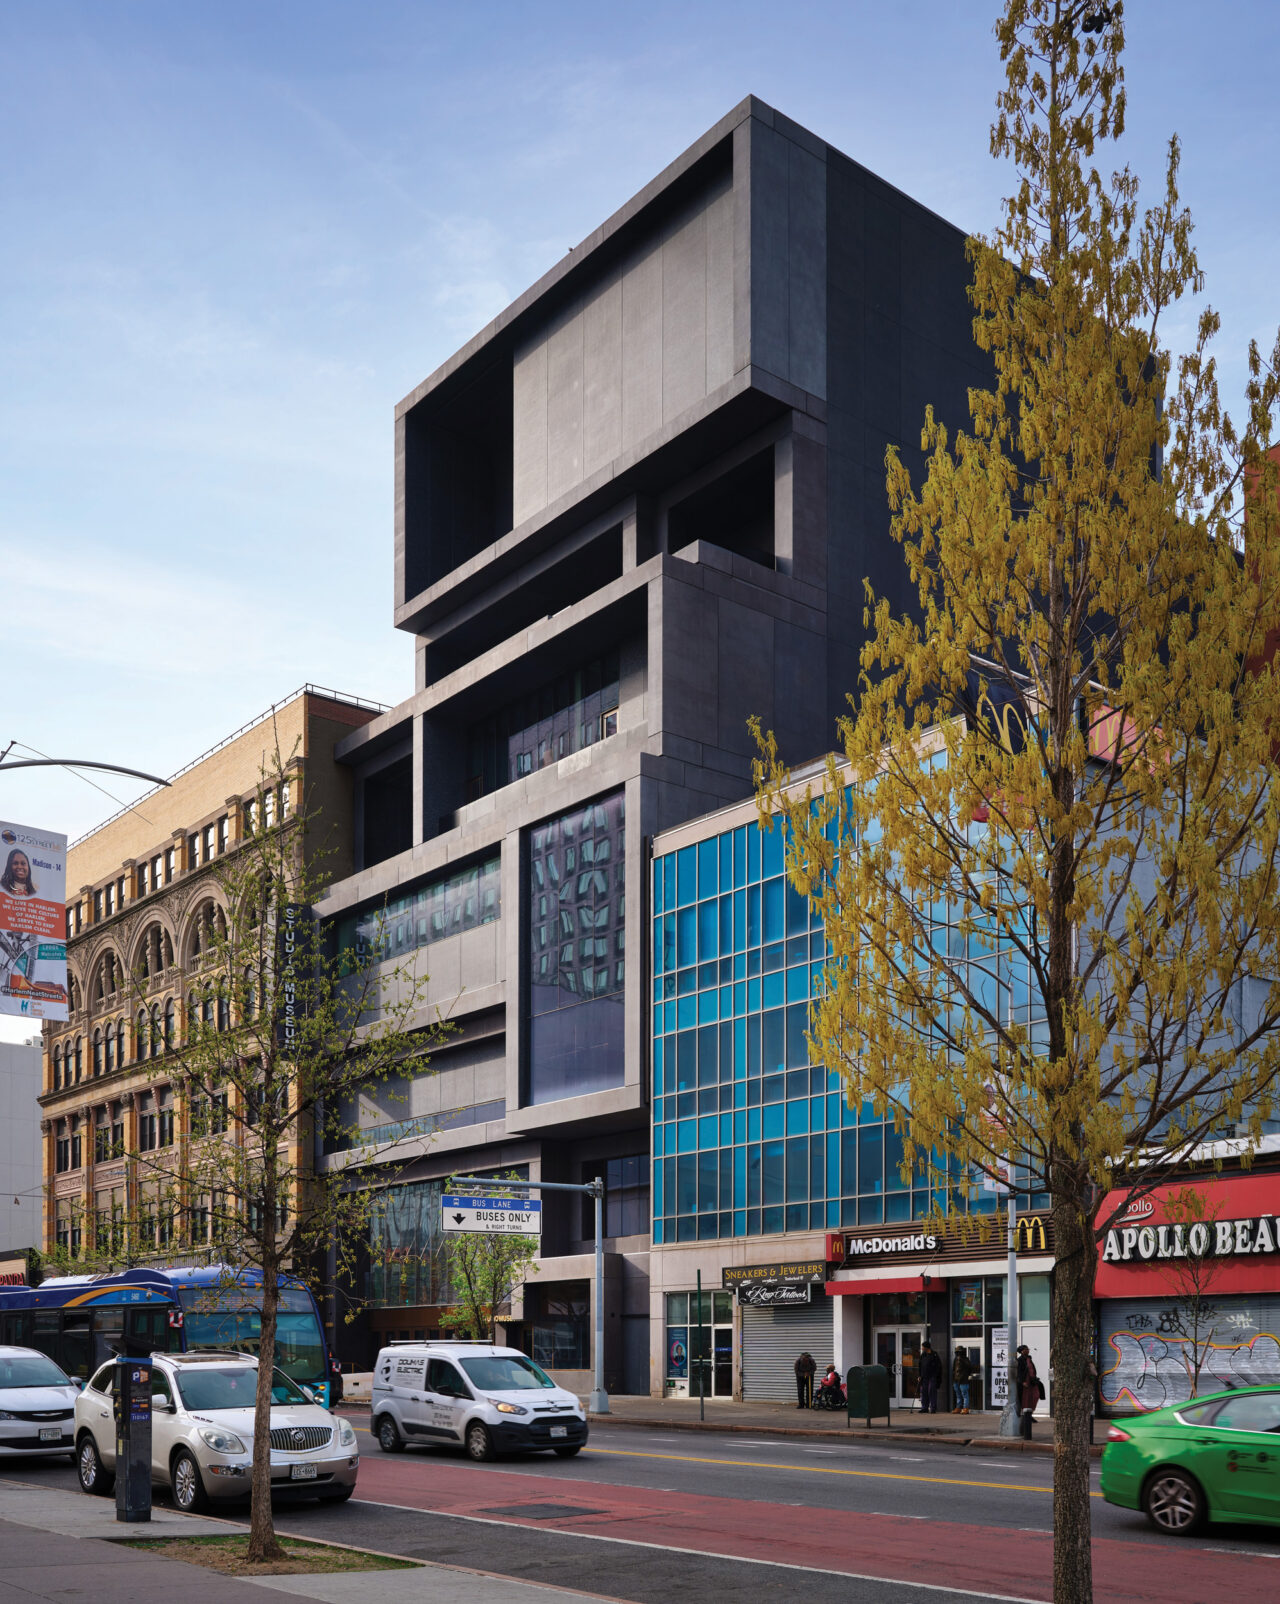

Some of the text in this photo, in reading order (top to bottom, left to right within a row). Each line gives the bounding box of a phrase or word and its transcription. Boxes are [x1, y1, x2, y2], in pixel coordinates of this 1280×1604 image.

[32, 857, 52, 870] Madison
[472, 1199, 512, 1209] BUS LANE
[476, 1211, 531, 1223] BUSES ONLY
[849, 1234, 936, 1254] McDonald's
[1102, 1217, 1280, 1261] APOLLO BEA
[725, 1264, 823, 1280] SNEAKERS & JEWELERS
[396, 1366, 423, 1375] ELECTRIC
